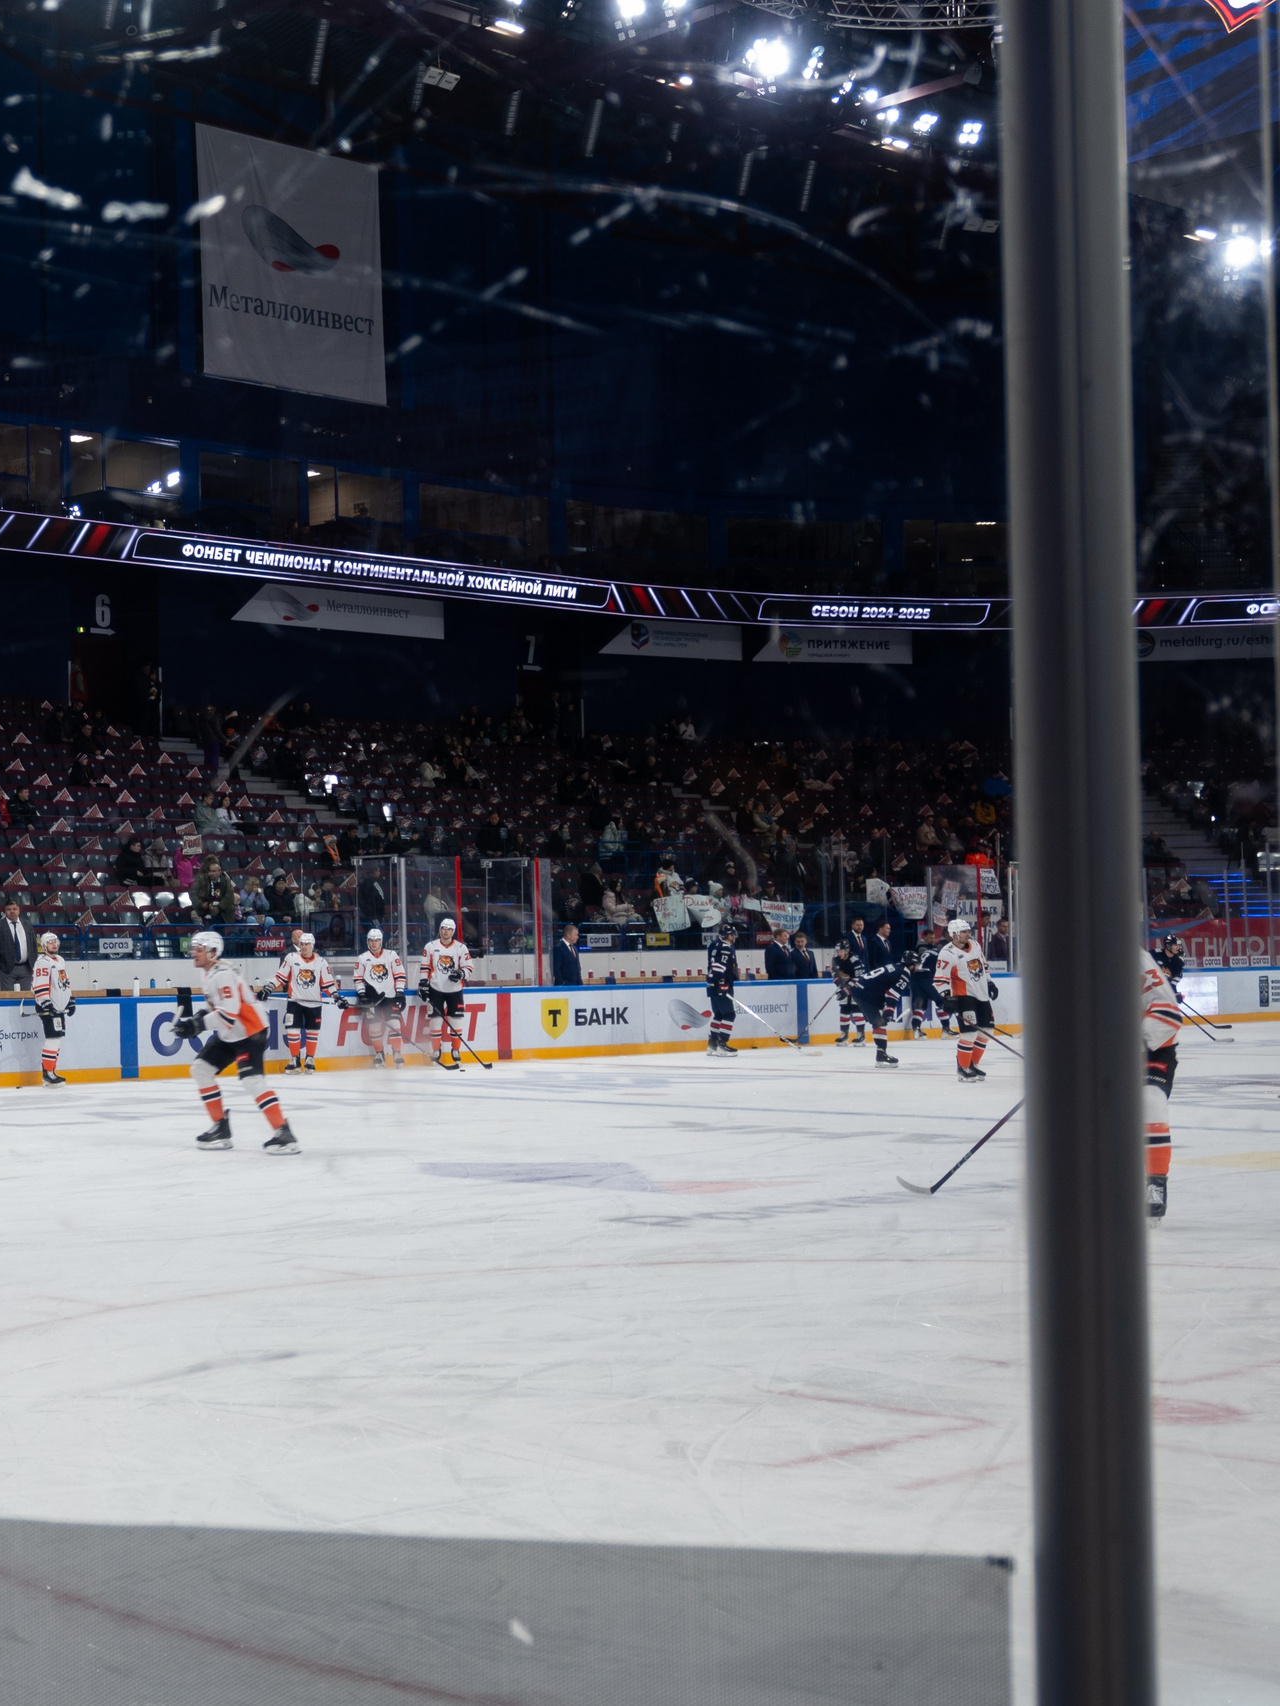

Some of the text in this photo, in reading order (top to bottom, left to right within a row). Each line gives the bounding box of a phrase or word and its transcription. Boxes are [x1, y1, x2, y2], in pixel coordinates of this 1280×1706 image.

[208, 284, 374, 335] Металлоинвест
[182, 543, 577, 600] ФОНБЕТ ЧЕМПИОНАТ КОНТИНЕНТАЛЬНОЙ ХОККЕЙНОЙ ЛИГИ
[95, 594, 111, 627] 6
[326, 600, 409, 619] Металлоинвест
[812, 605, 931, 619] СЕЗОН 2024-2025
[807, 639, 891, 650] ПРИТЯЖЕНИЕ
[256, 939, 285, 948] FONBET
[35, 967, 49, 977] 85
[574, 1007, 629, 1026] БАНК
